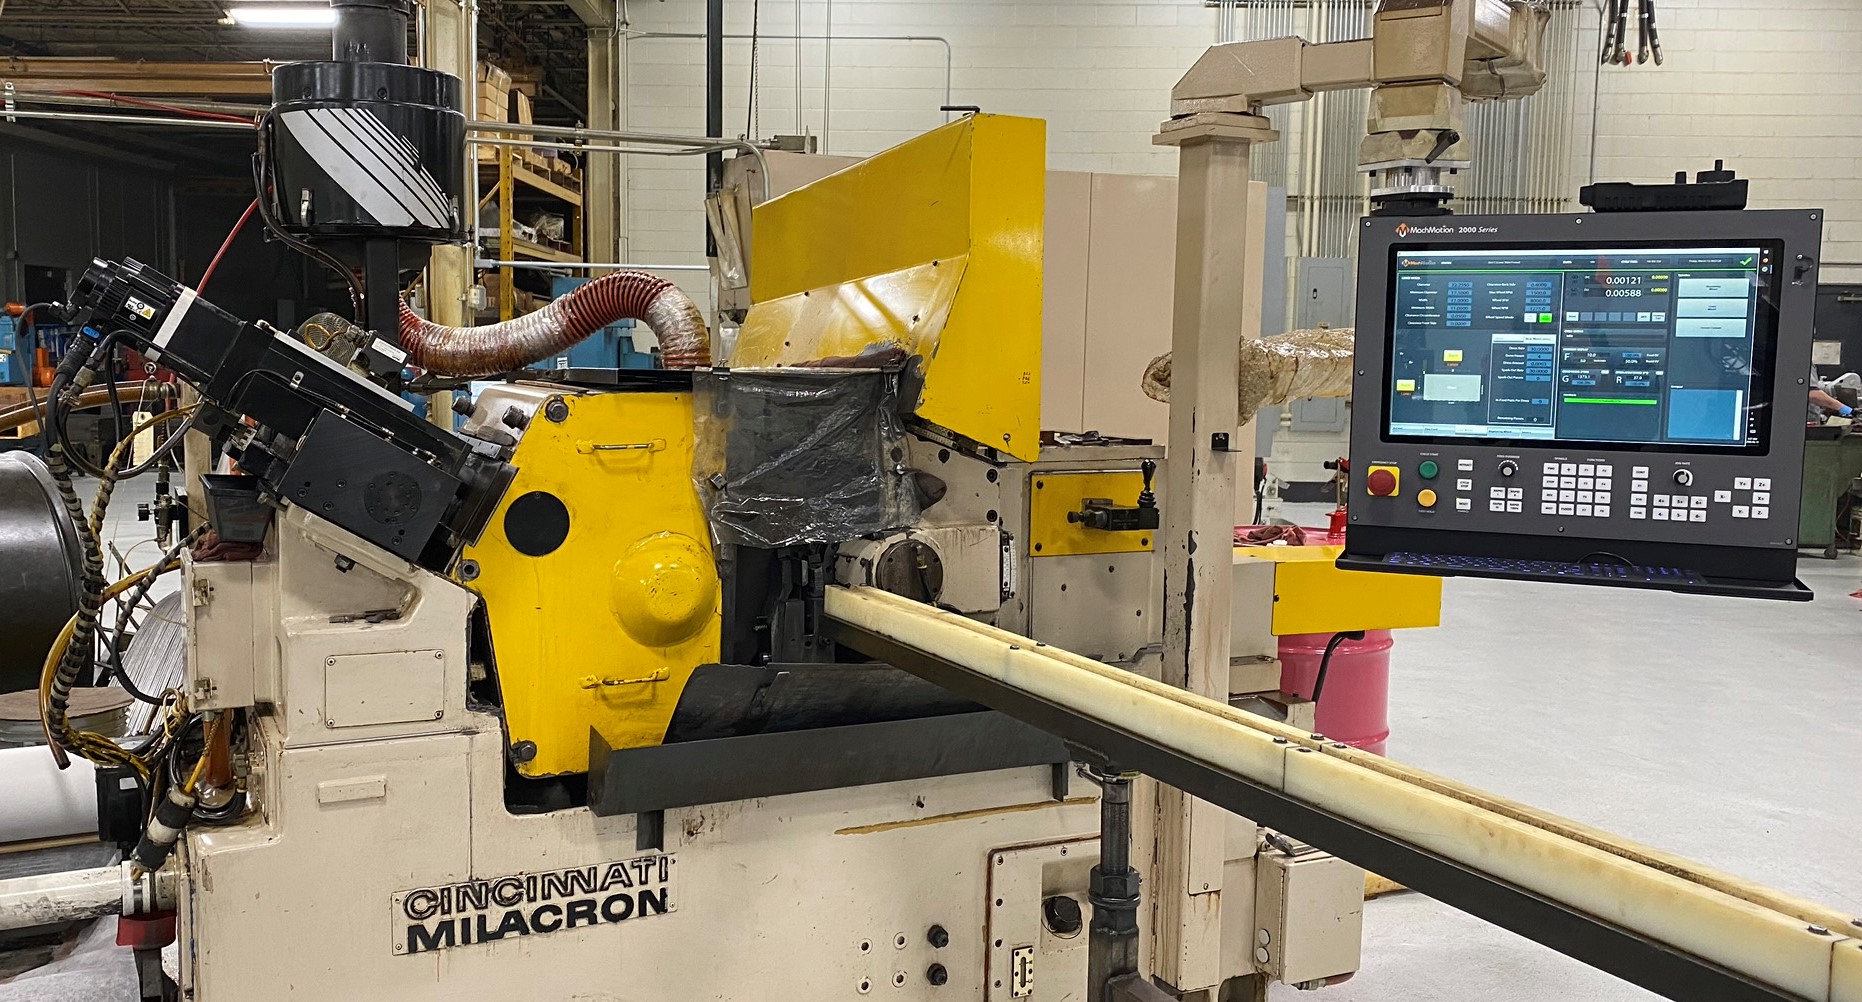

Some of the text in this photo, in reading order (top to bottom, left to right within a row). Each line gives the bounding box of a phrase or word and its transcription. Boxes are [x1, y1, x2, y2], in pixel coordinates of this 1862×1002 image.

[1410, 225, 1454, 234] MachMotion
[1606, 276, 1641, 284] 0.00121
[403, 856, 669, 921] CINCINNATI
[407, 887, 668, 954] MILACRON
